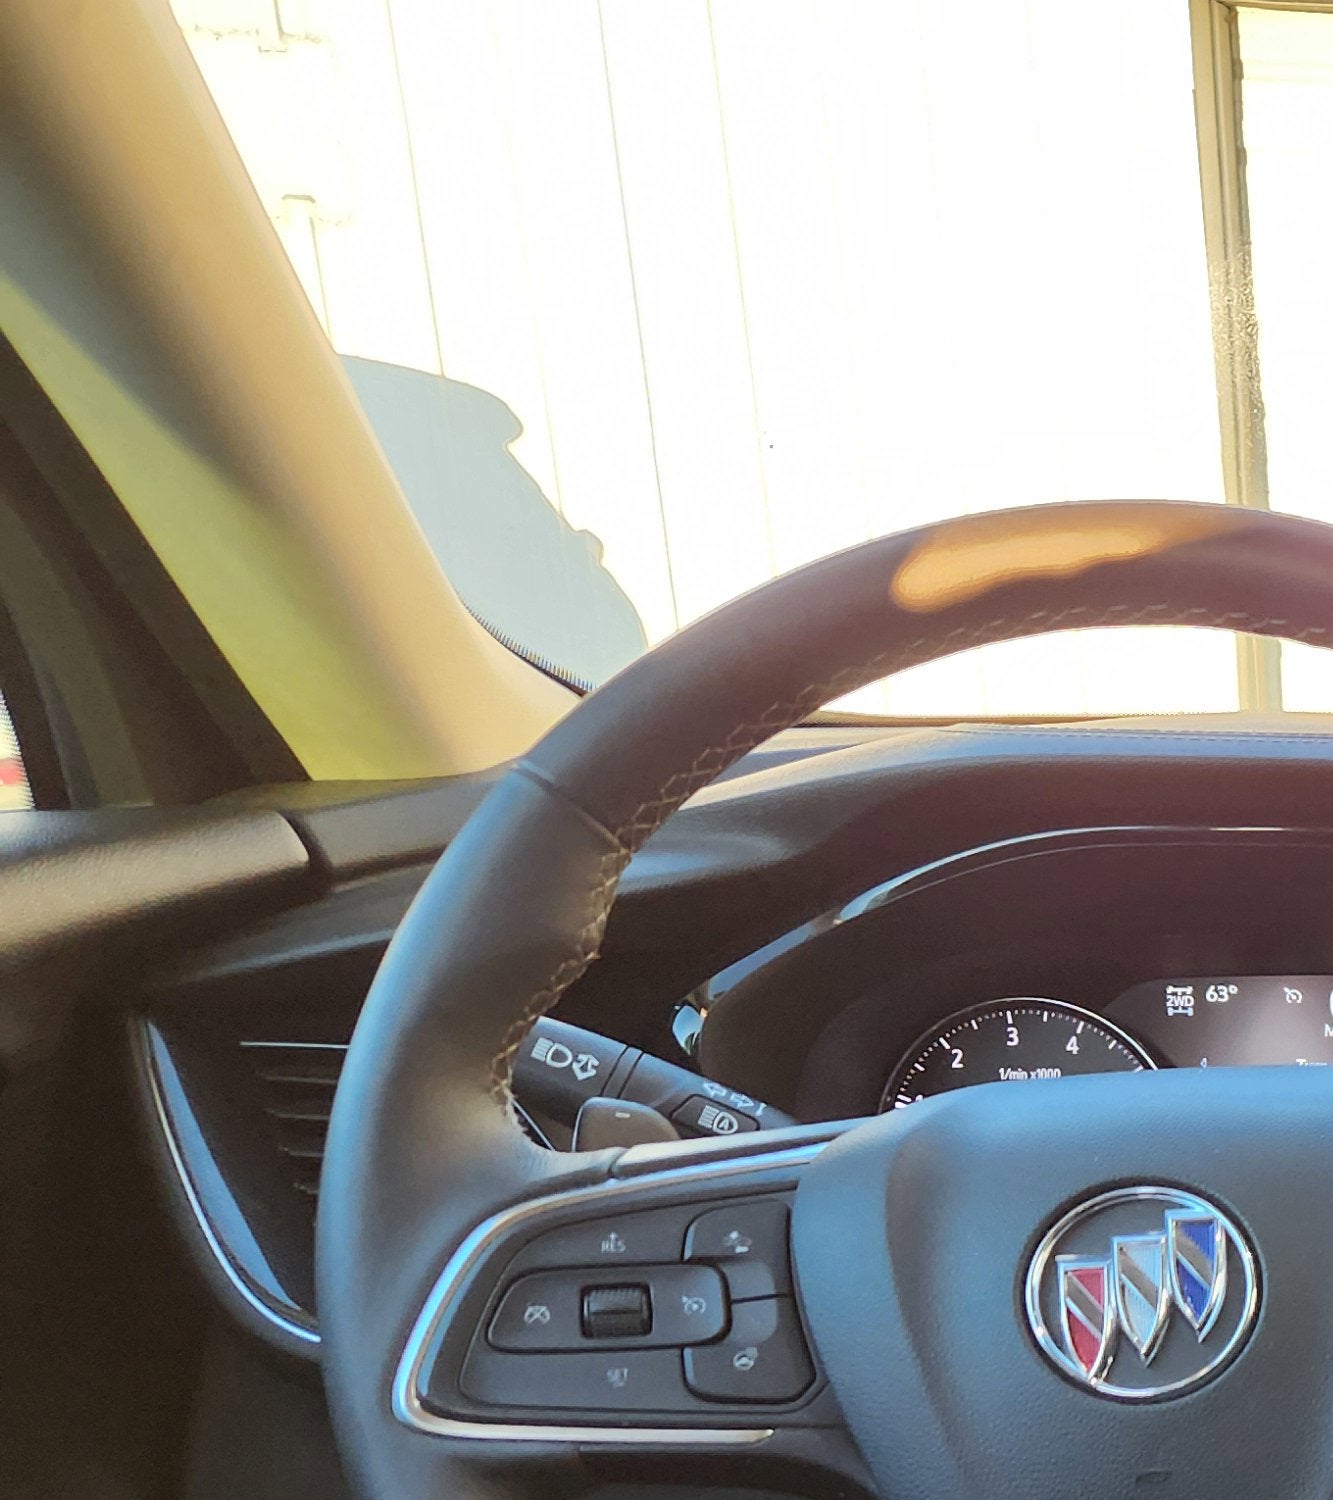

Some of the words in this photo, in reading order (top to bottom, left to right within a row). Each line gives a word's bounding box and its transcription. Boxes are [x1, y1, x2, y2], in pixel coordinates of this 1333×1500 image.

[1166, 994, 1195, 1007] 2WD
[1205, 985, 1238, 1002] 63°
[1006, 1026, 1020, 1047] 3
[1065, 1035, 1080, 1055] 4
[950, 1048, 964, 1069] 2
[998, 1067, 1028, 1080] 1/min
